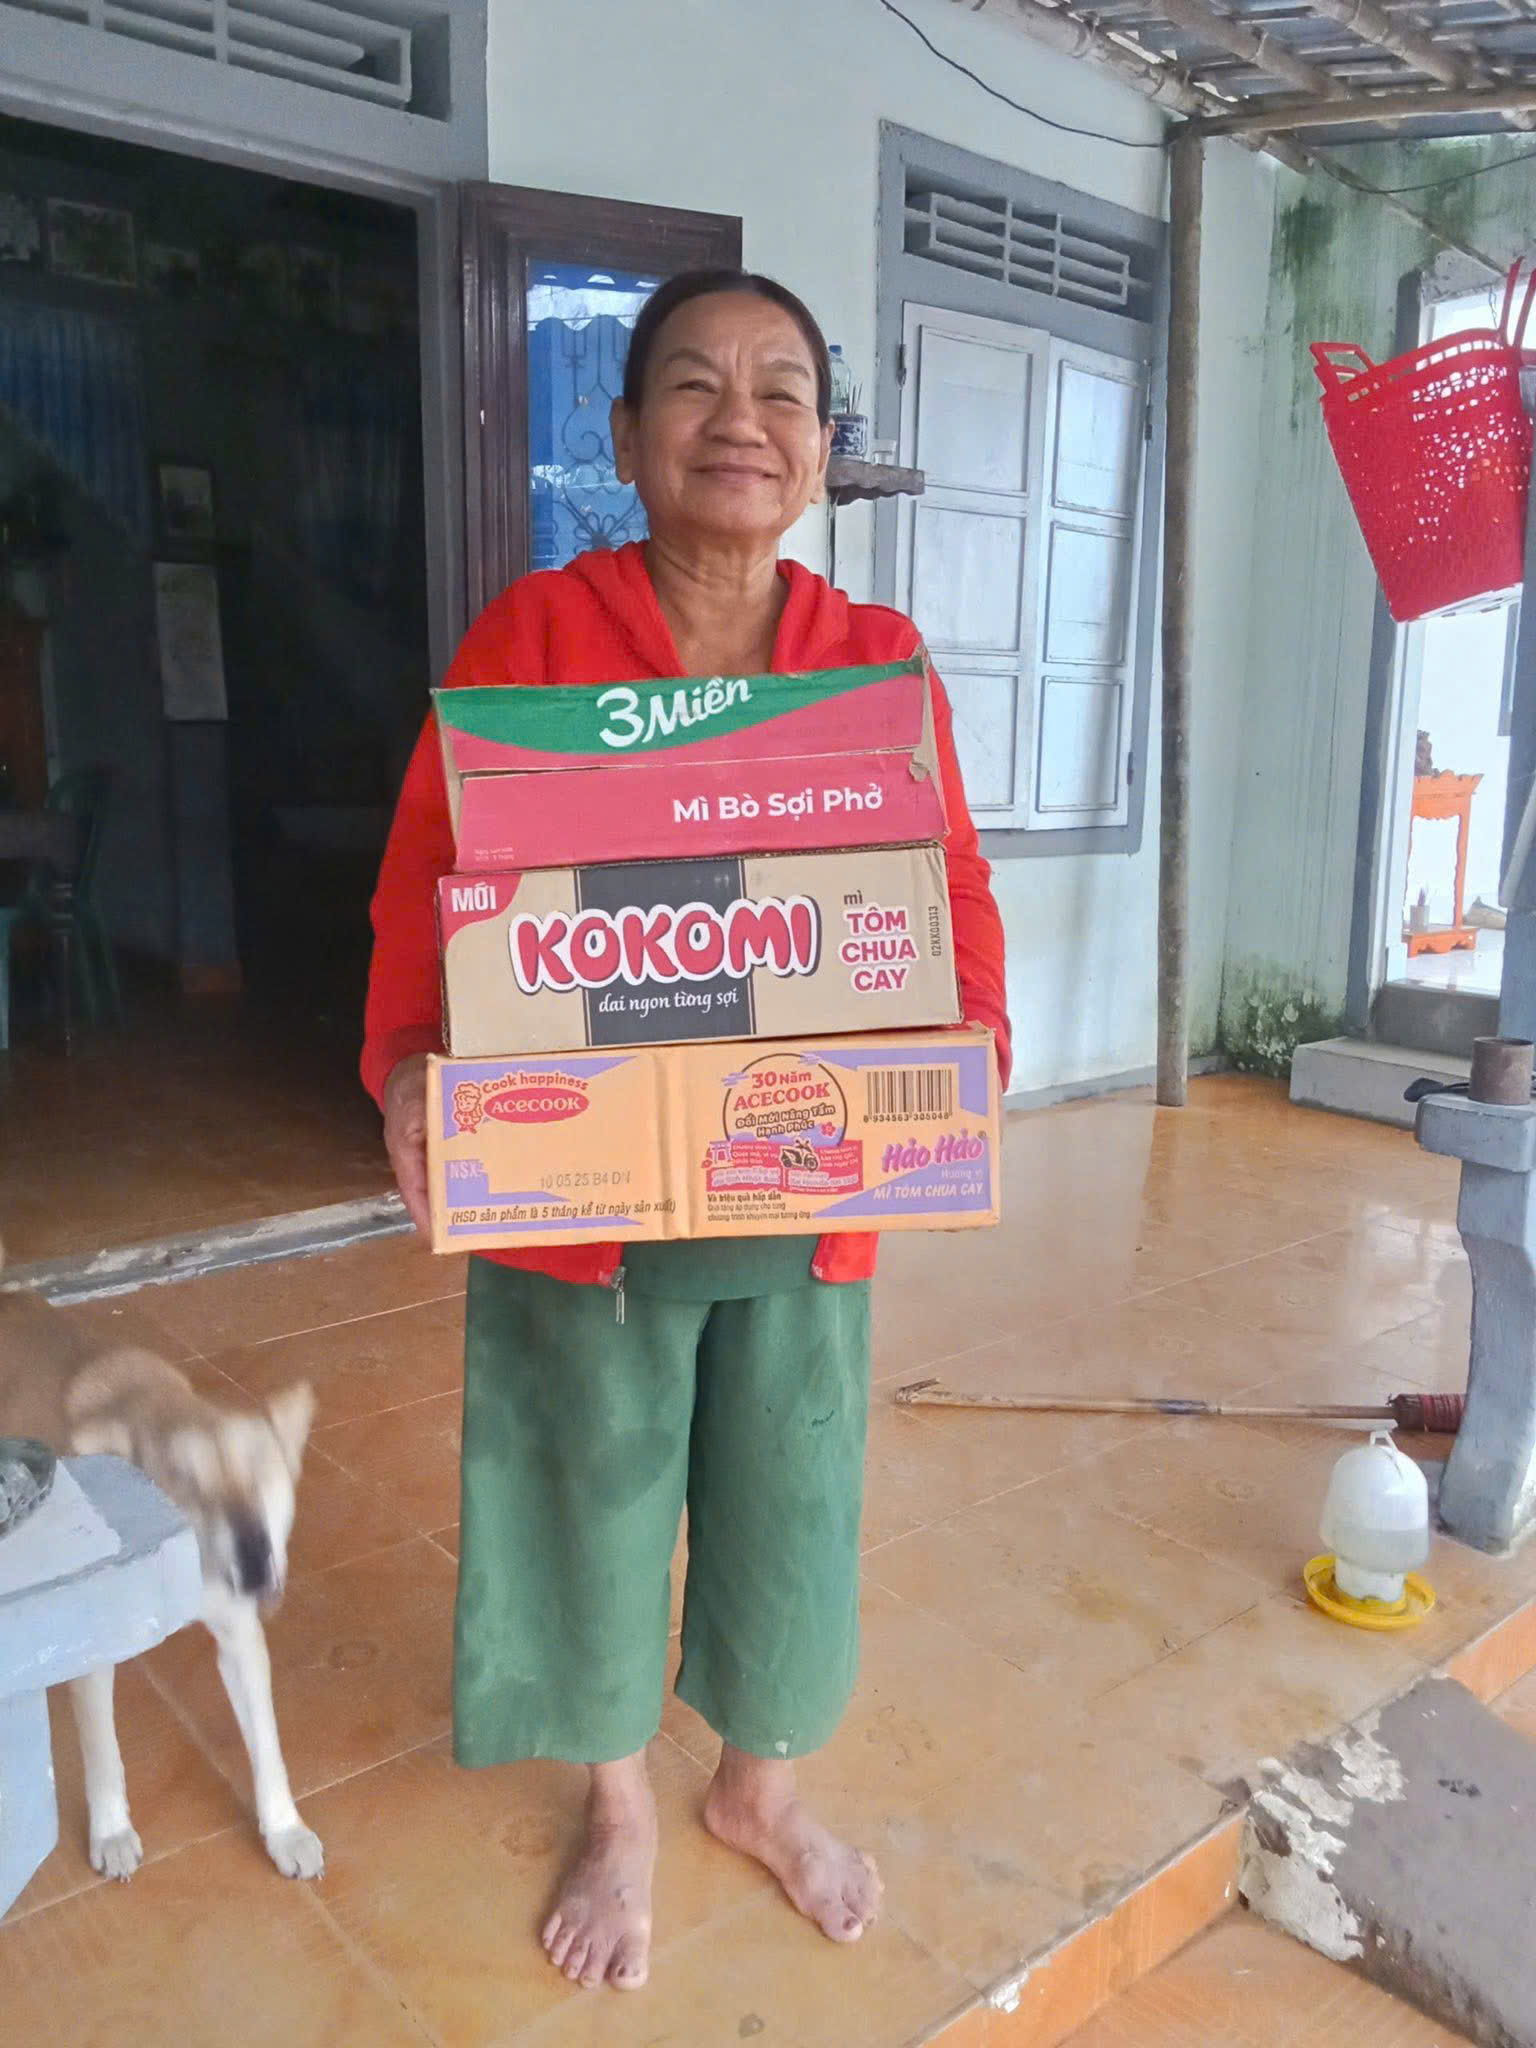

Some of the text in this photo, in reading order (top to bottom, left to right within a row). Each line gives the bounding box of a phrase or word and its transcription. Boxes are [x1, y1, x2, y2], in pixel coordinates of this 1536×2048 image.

[596, 676, 752, 747] 3 Miền
[672, 783, 883, 823] Mì Bò Sợi Phở
[452, 881, 496, 912] MỚI
[844, 889, 863, 905] mì
[846, 906, 907, 934] TÔM
[513, 898, 817, 991] KOKOMI
[841, 939, 917, 963] CHUA
[854, 968, 907, 992] CAY
[599, 993, 626, 1013] dai
[629, 998, 671, 1018] ngon
[716, 988, 739, 1007] sợi
[482, 1071, 589, 1094] Cook happiness
[752, 1071, 812, 1089] 30 Năm
[733, 1082, 831, 1112] ACECOOK
[882, 1128, 983, 1173] Hảo Hảo
[556, 1173, 571, 1188] 05
[574, 1173, 589, 1187] 25
[925, 1182, 957, 1197] CHUA
[960, 1181, 984, 1196] CAY
[451, 1210, 477, 1224] (HSD
[500, 1205, 526, 1222] phẩm
[541, 1206, 548, 1218] 5
[608, 1201, 630, 1217] ngày
